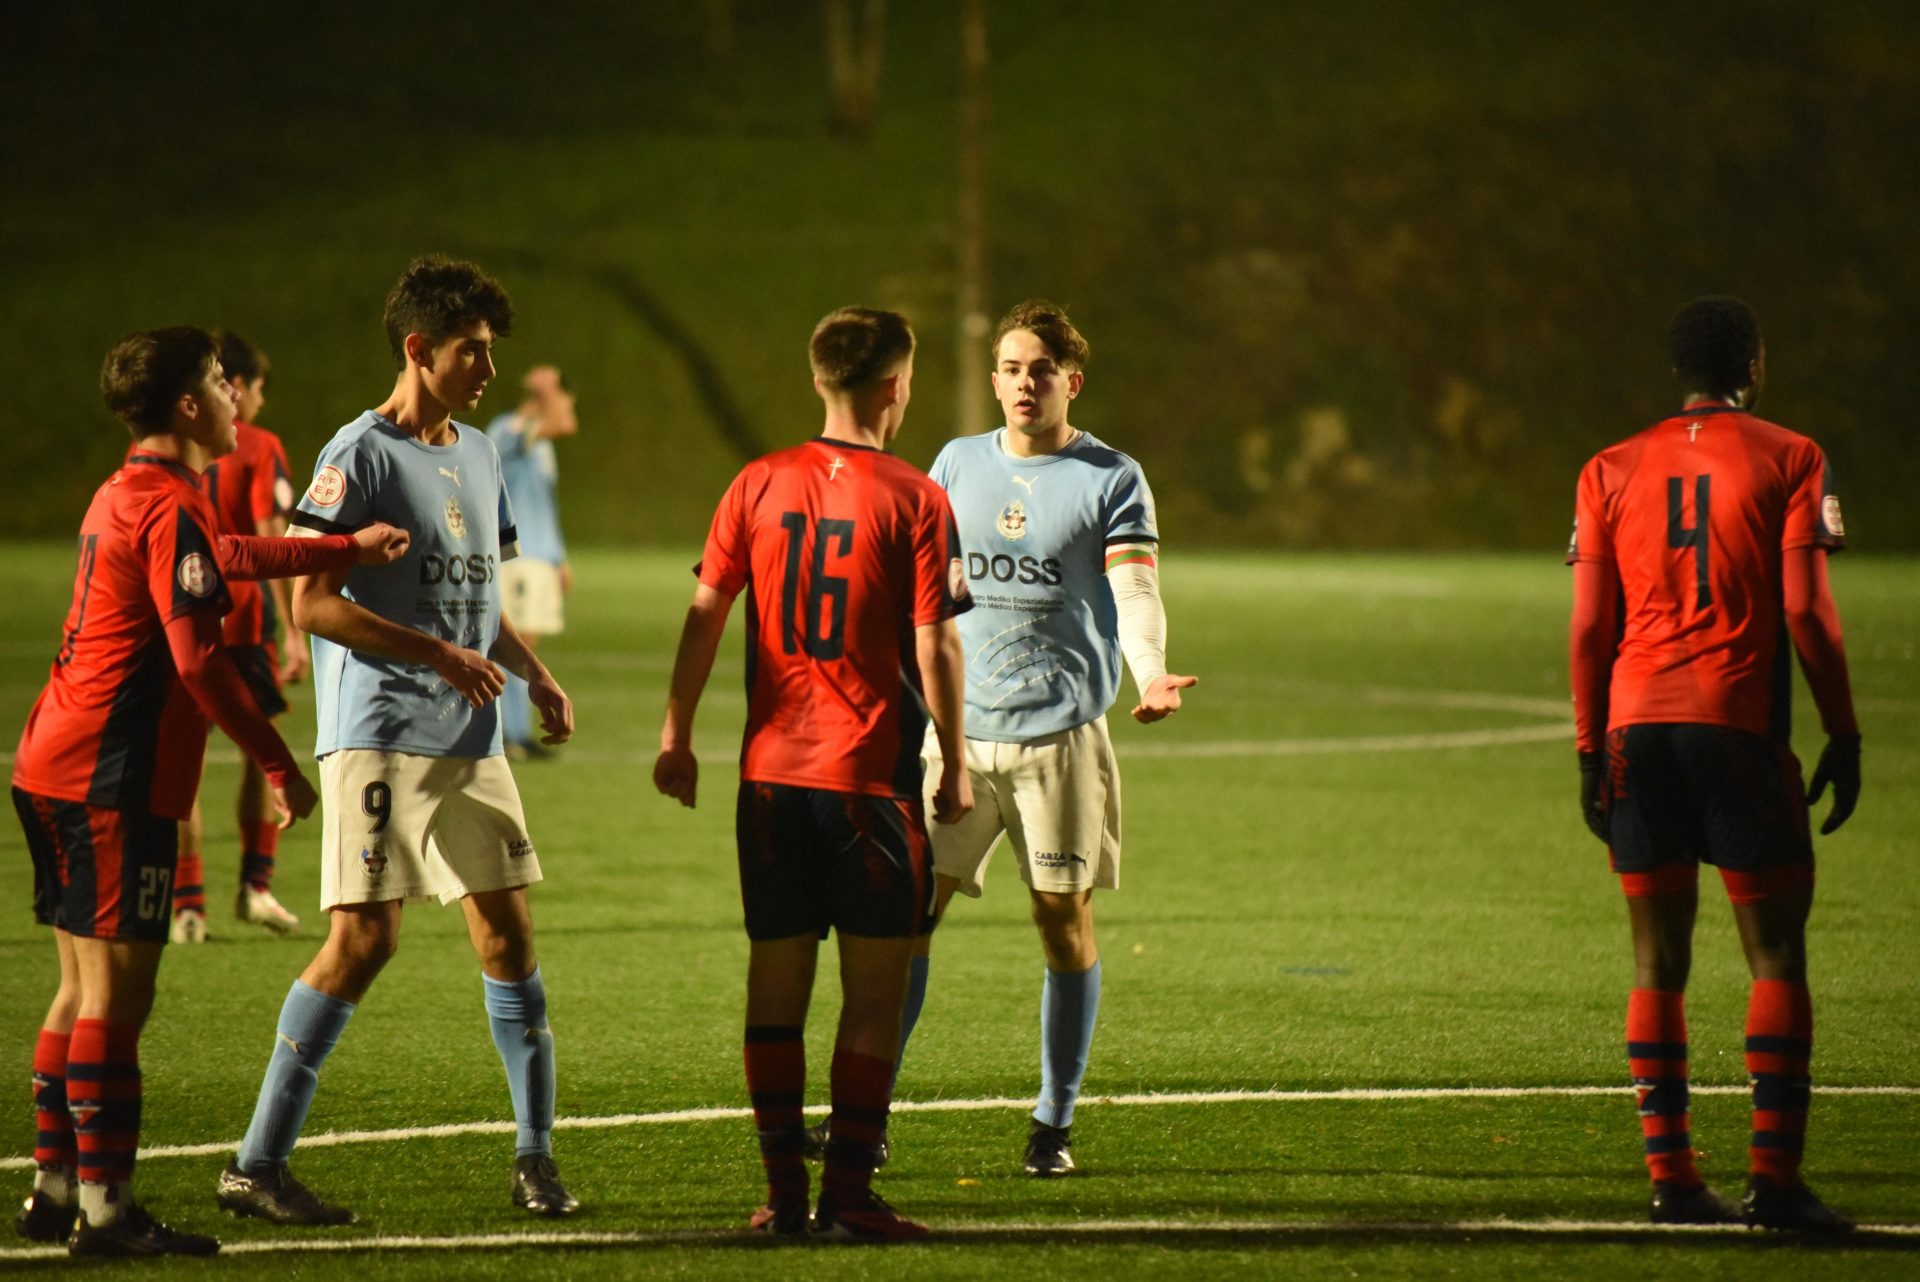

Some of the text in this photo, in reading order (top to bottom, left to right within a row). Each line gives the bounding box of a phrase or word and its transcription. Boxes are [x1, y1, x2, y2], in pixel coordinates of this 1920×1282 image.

[420, 553, 494, 586] DOSS
[967, 551, 1063, 586] DOSS
[1667, 474, 1711, 611] 4
[781, 511, 856, 661] 16
[361, 780, 392, 834] 9
[138, 866, 170, 921] 27
